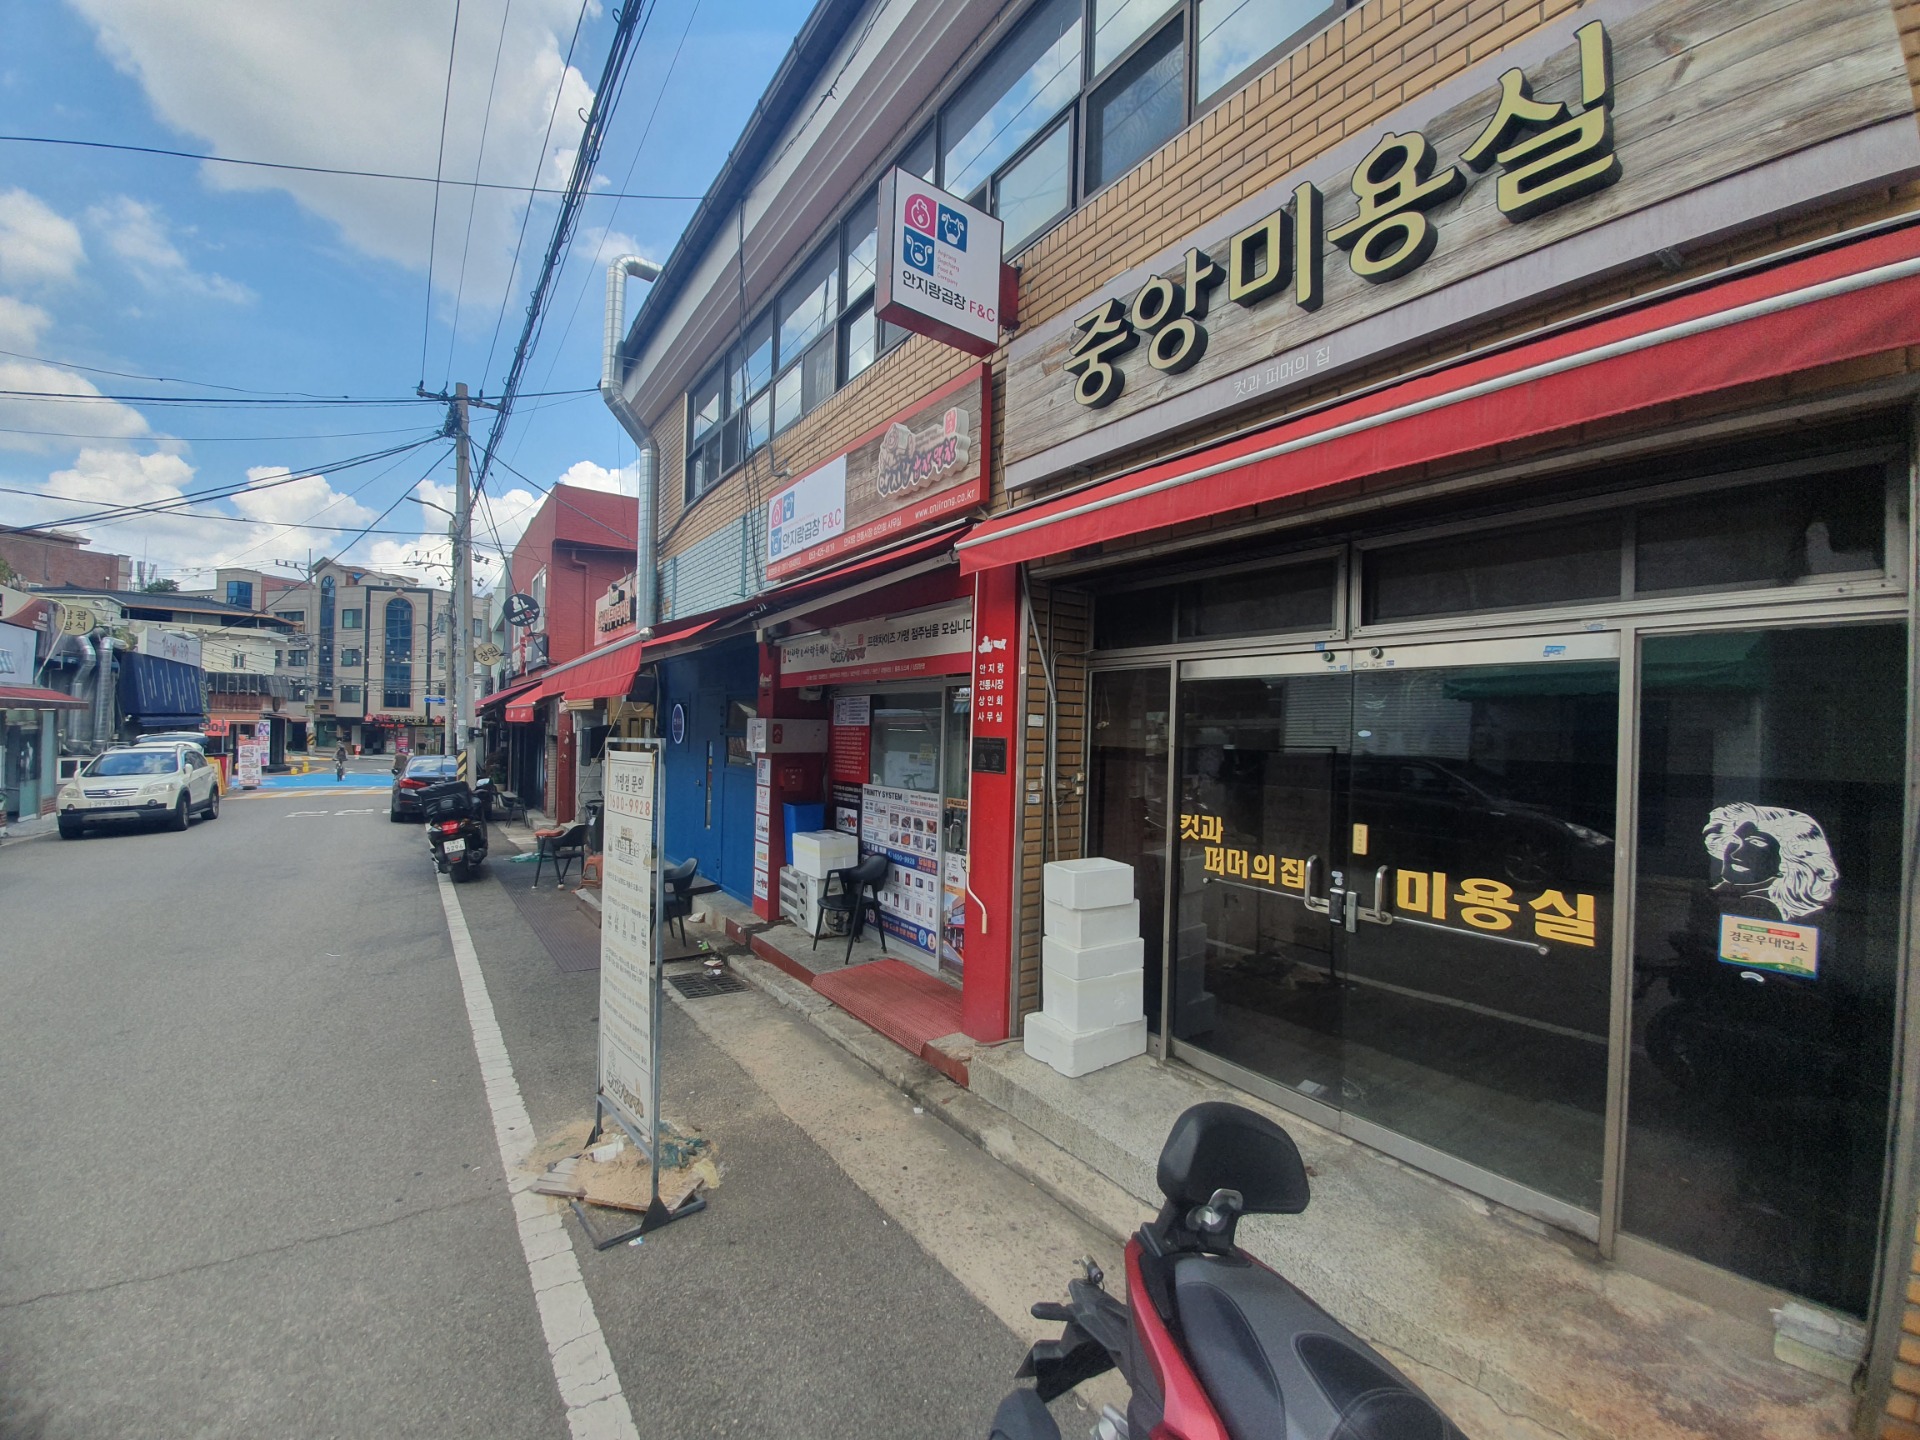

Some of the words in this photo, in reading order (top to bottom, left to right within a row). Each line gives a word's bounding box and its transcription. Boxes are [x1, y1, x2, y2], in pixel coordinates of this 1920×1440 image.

[1064, 19, 1622, 408] 중앙미용실
[902, 270, 967, 311] 안지랑곱창
[969, 300, 996, 323] F&C
[1234, 374, 1261, 399] 컷과
[1265, 354, 1309, 386] 퍼머의
[1316, 345, 1331, 368] 집
[782, 517, 821, 550] 안지랑곱창
[822, 508, 842, 532] F&C
[478, 645, 500, 662] 장원
[979, 662, 1005, 675] 안지랑
[978, 678, 1005, 691] 전통시장
[978, 694, 1004, 708] 상인회
[977, 711, 1003, 723] 사무실
[631, 775, 645, 793] 문의
[864, 786, 882, 798] TRINITY
[882, 789, 903, 801] SYSTEM
[609, 793, 651, 817] 1600-9928
[1180, 813, 1224, 844] 컷과
[1395, 868, 1596, 948] 미용실
[1729, 930, 1810, 953] 경로우대업소
